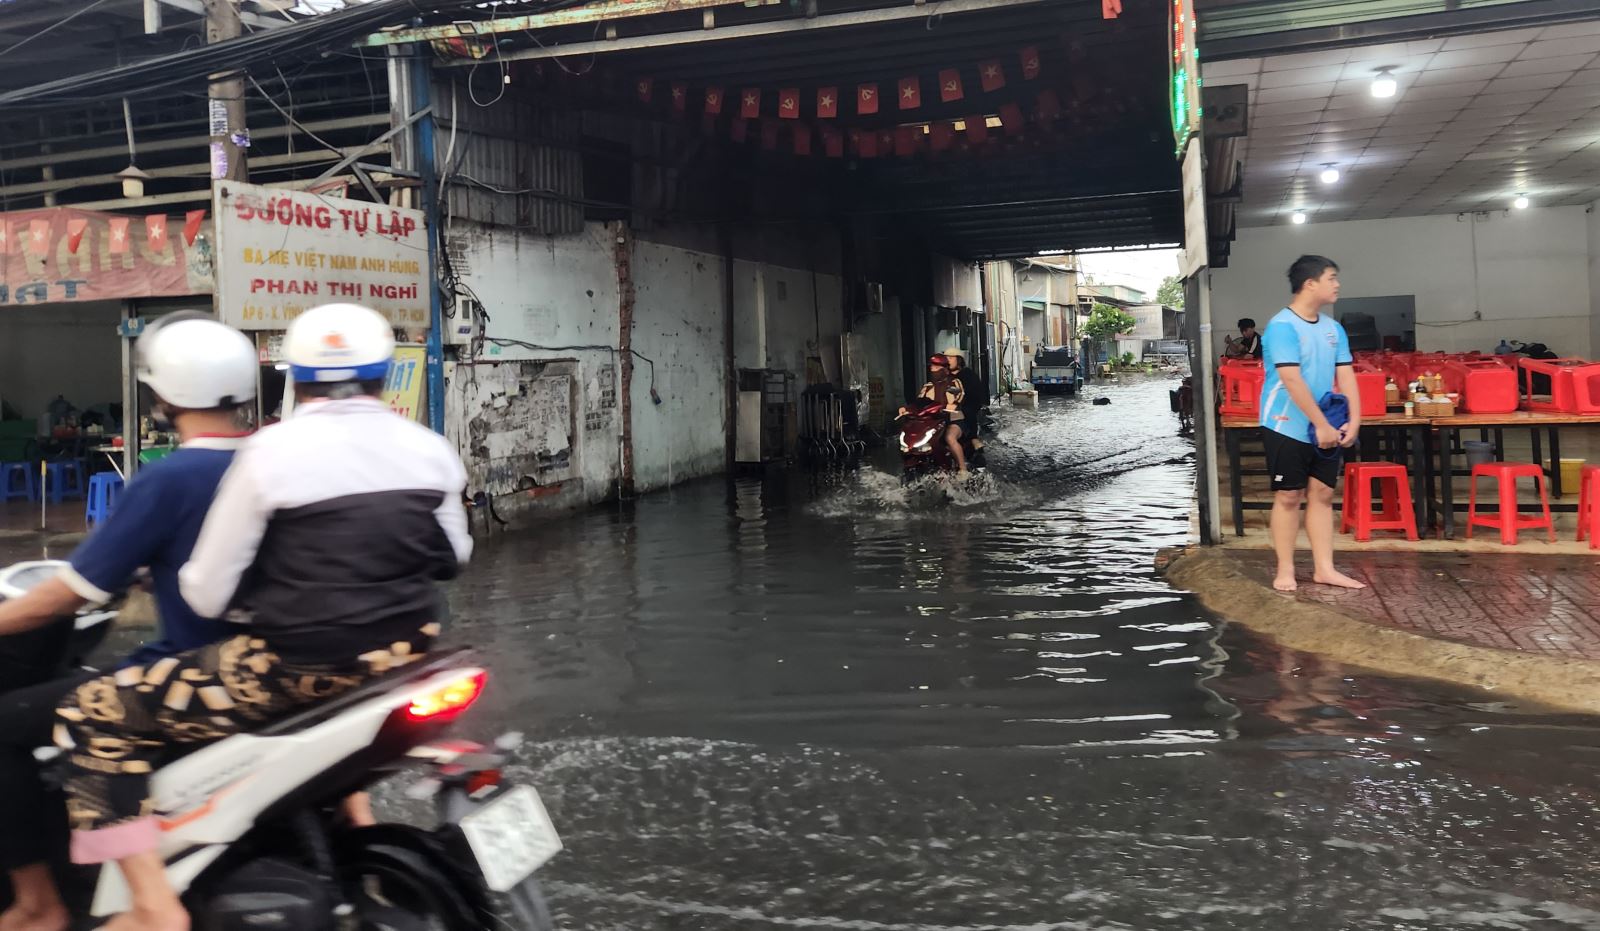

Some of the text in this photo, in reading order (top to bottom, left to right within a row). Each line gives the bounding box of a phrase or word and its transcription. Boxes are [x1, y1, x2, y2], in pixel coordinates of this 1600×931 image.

[338, 207, 370, 237] TỰ
[376, 209, 416, 242] LẬP
[294, 247, 326, 272] VIỆT
[329, 254, 357, 271] NAM
[360, 257, 386, 273] ANH
[250, 278, 319, 295] PHAN
[326, 281, 362, 300] THỊ
